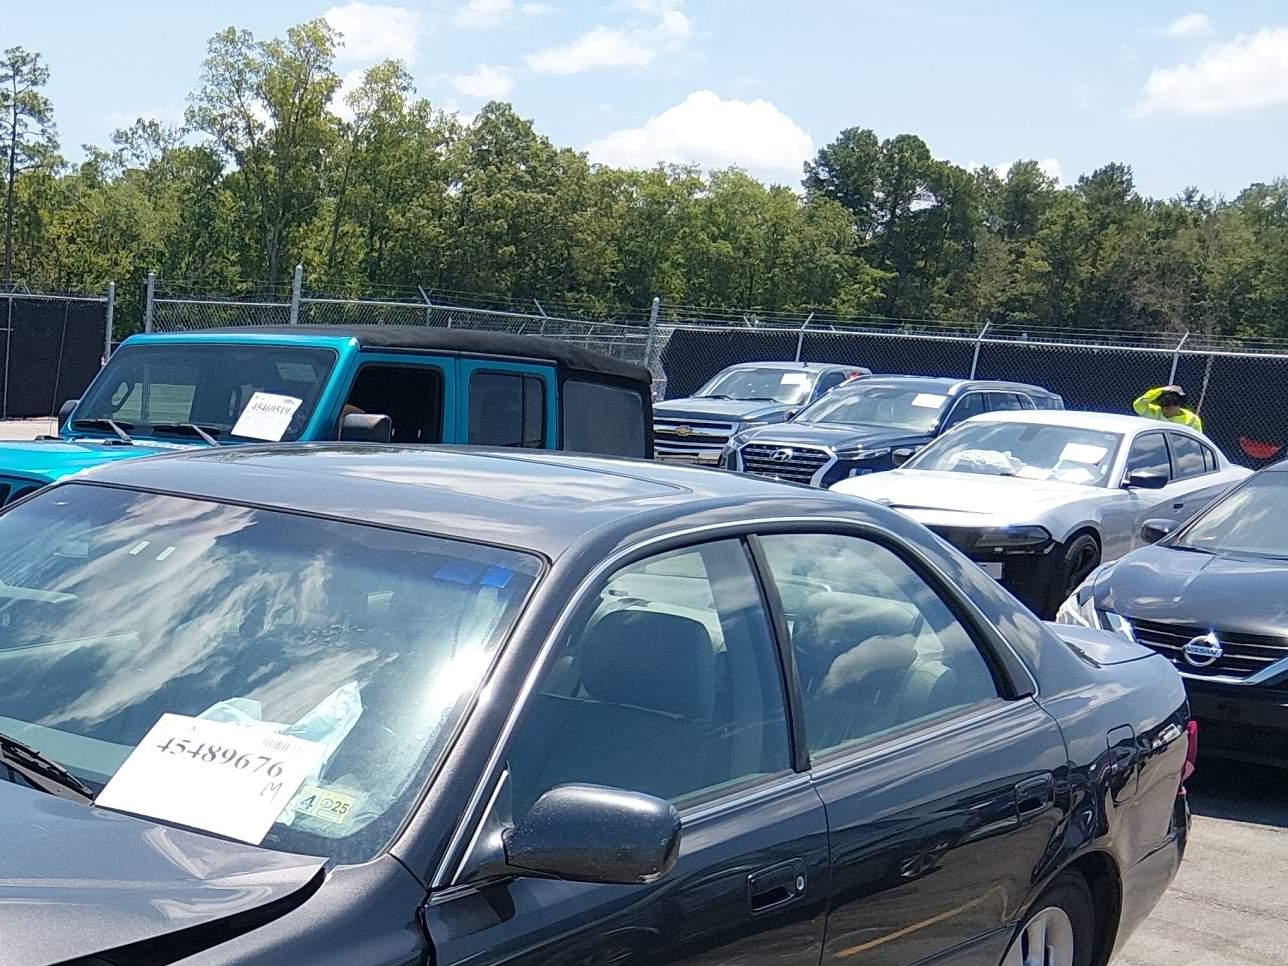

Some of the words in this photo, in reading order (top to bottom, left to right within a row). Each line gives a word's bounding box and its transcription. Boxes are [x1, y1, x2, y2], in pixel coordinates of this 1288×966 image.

[1185, 645, 1218, 656] NISSAN
[156, 737, 284, 778] 45489676
[331, 800, 350, 815] 25
